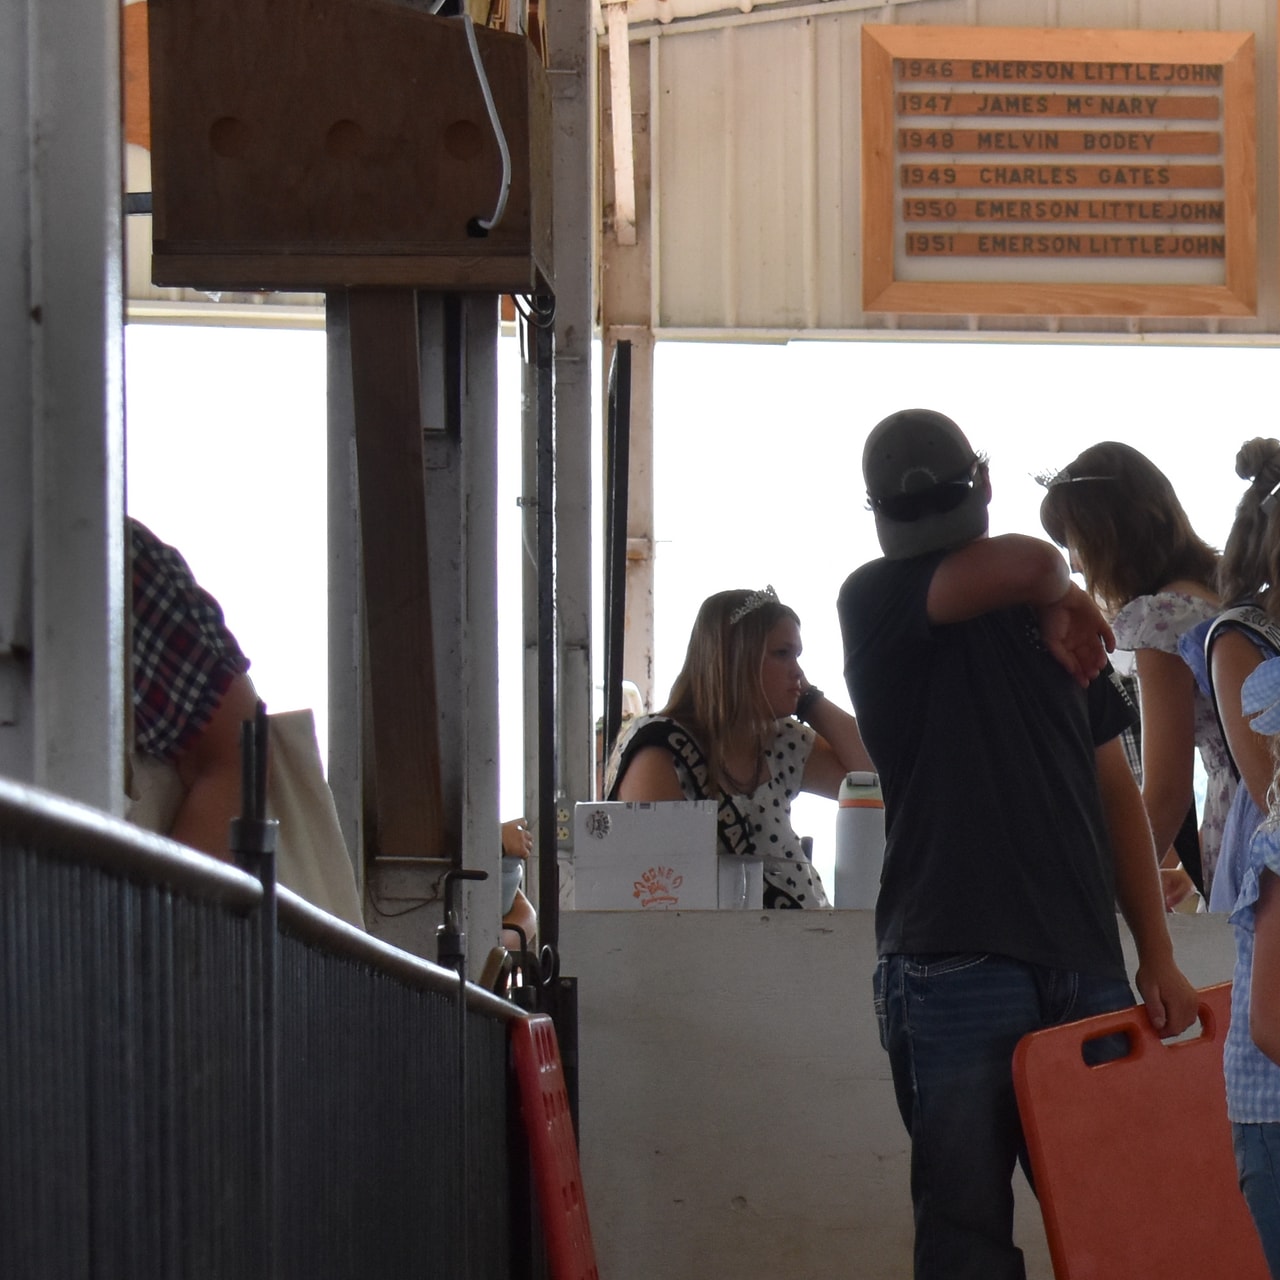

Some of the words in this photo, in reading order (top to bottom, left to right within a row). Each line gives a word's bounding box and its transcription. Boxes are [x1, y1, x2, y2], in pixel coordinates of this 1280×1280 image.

[900, 61, 954, 78] 1946
[972, 62, 1074, 79] EMERSON
[1085, 63, 1221, 81] LITTLEJOHN
[902, 96, 953, 112] 1947
[977, 96, 1048, 113] JAMES
[902, 132, 954, 148] 1948
[978, 132, 1059, 149] MELVIN
[1084, 135, 1155, 150] BODEY
[903, 168, 956, 183] 1949
[980, 168, 1077, 184] CHARLES
[1099, 169, 1169, 184] GATES
[906, 201, 956, 217] 1950
[976, 202, 1078, 218] EMERSON
[1089, 204, 1224, 219] LITTLEJOHN
[908, 236, 954, 252] 1951
[978, 237, 1080, 252] EMERSON
[1090, 238, 1224, 254] LITTLEJOHN
